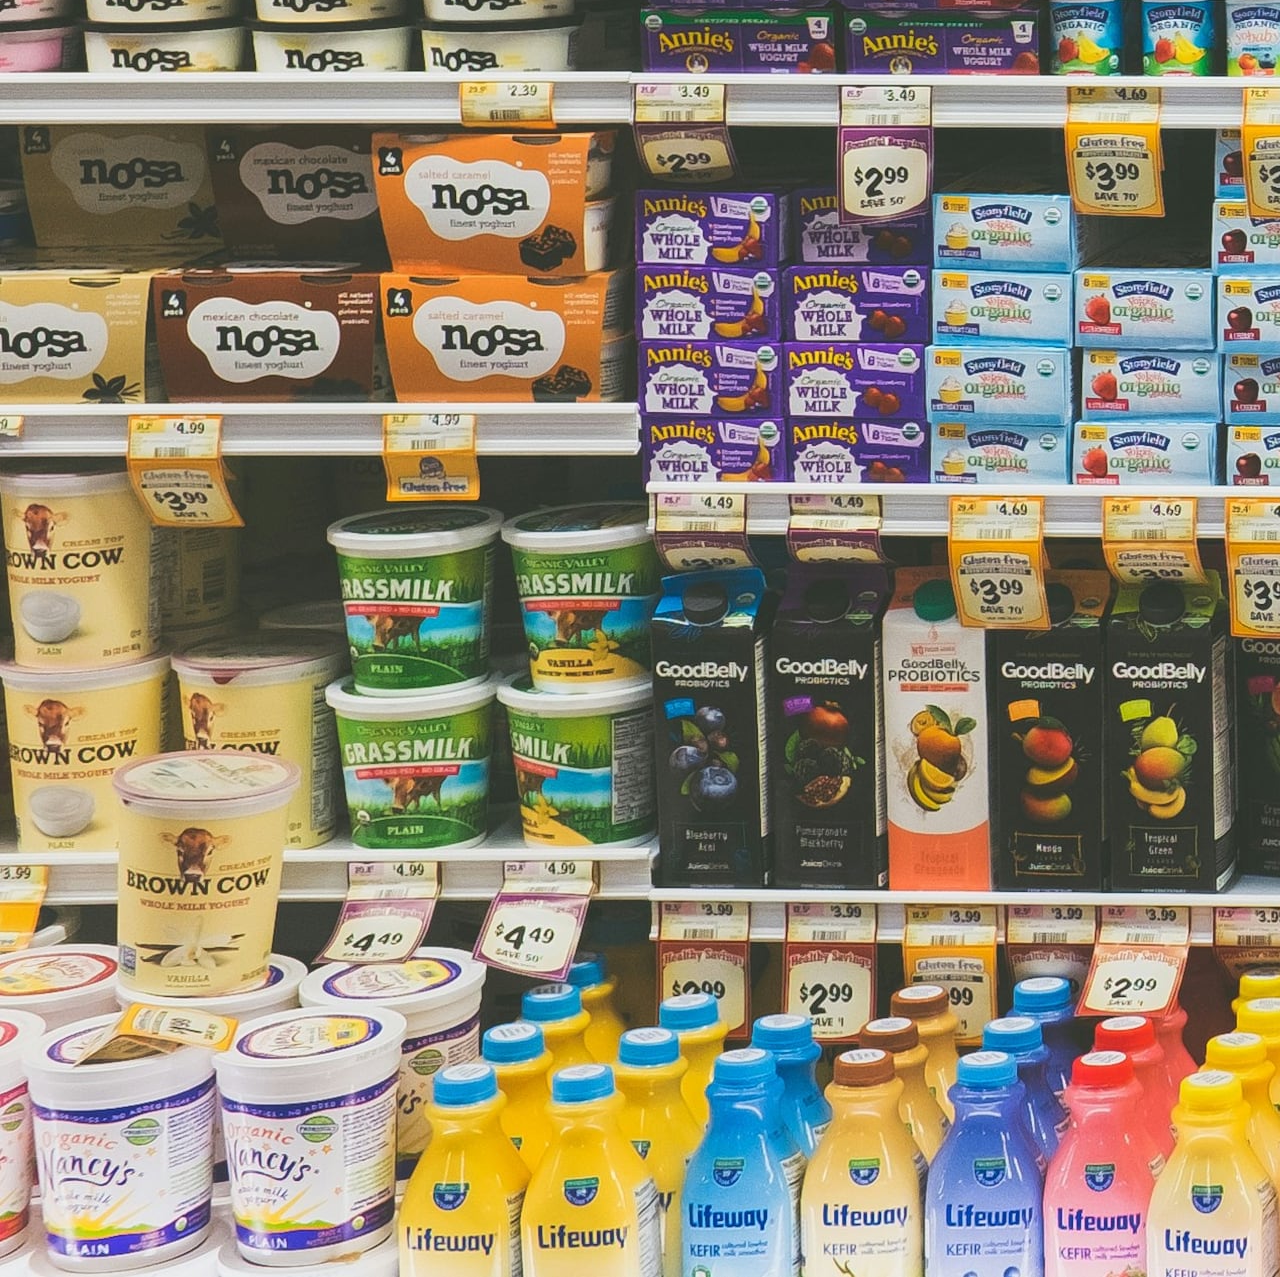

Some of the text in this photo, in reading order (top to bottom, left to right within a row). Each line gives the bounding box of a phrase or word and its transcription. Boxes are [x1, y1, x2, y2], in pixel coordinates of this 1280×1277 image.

[643, 272, 708, 294] Annie's
[248, 311, 299, 322] chocolate
[216, 326, 319, 355] noosa
[658, 324, 695, 337] MILK
[264, 360, 304, 373] yoghurt
[656, 660, 748, 683] GoodBelly
[888, 669, 980, 682] PROBIOTICS
[345, 738, 473, 762] GRASSMILK
[126, 868, 270, 896] BROWN COW
[688, 1203, 768, 1230] Lifeway
[406, 1226, 495, 1255] Lifeway
[690, 1244, 720, 1258] KEFIR
